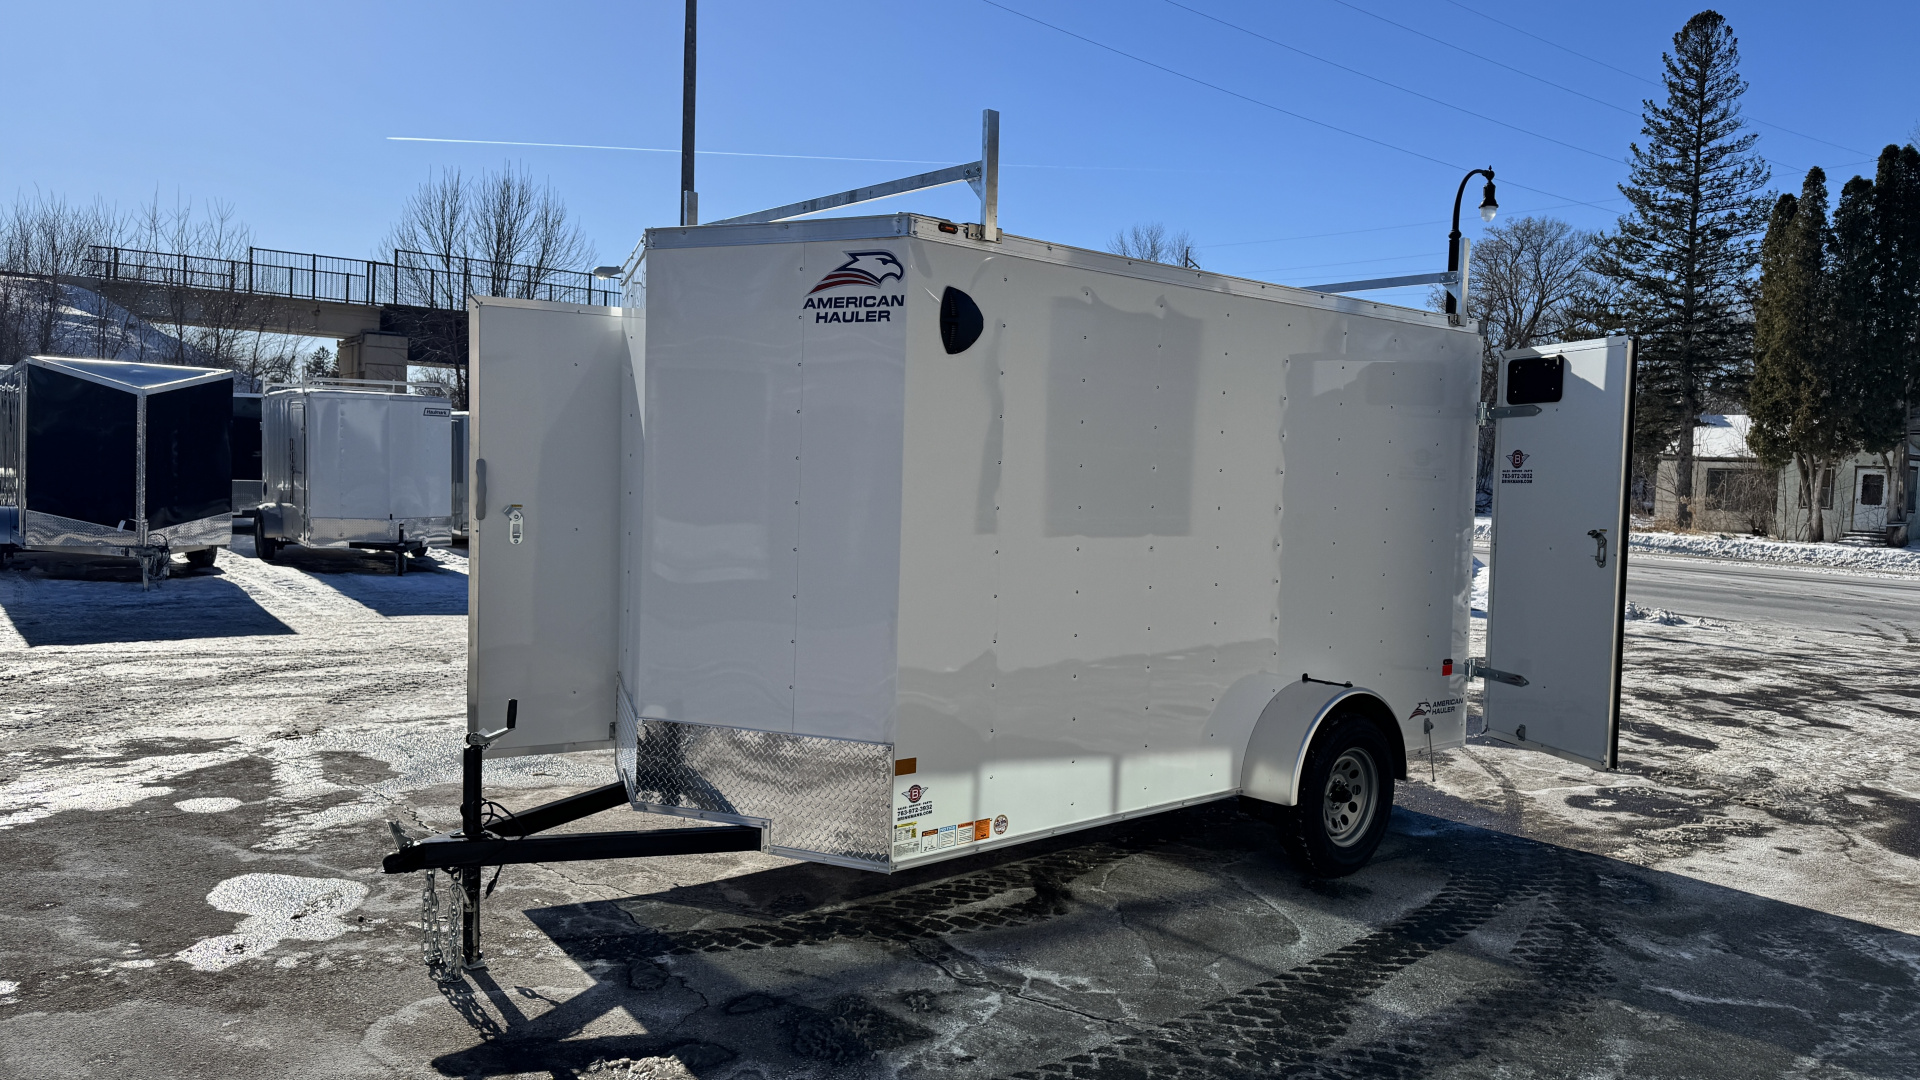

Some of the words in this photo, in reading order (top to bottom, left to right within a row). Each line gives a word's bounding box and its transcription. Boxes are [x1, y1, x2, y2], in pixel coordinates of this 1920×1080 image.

[803, 295, 905, 309] AMERICAN
[815, 310, 891, 323] HAULER
[1432, 698, 1464, 708] AMERICAN
[1432, 706, 1455, 715] HAULER
[912, 789, 919, 799] B
